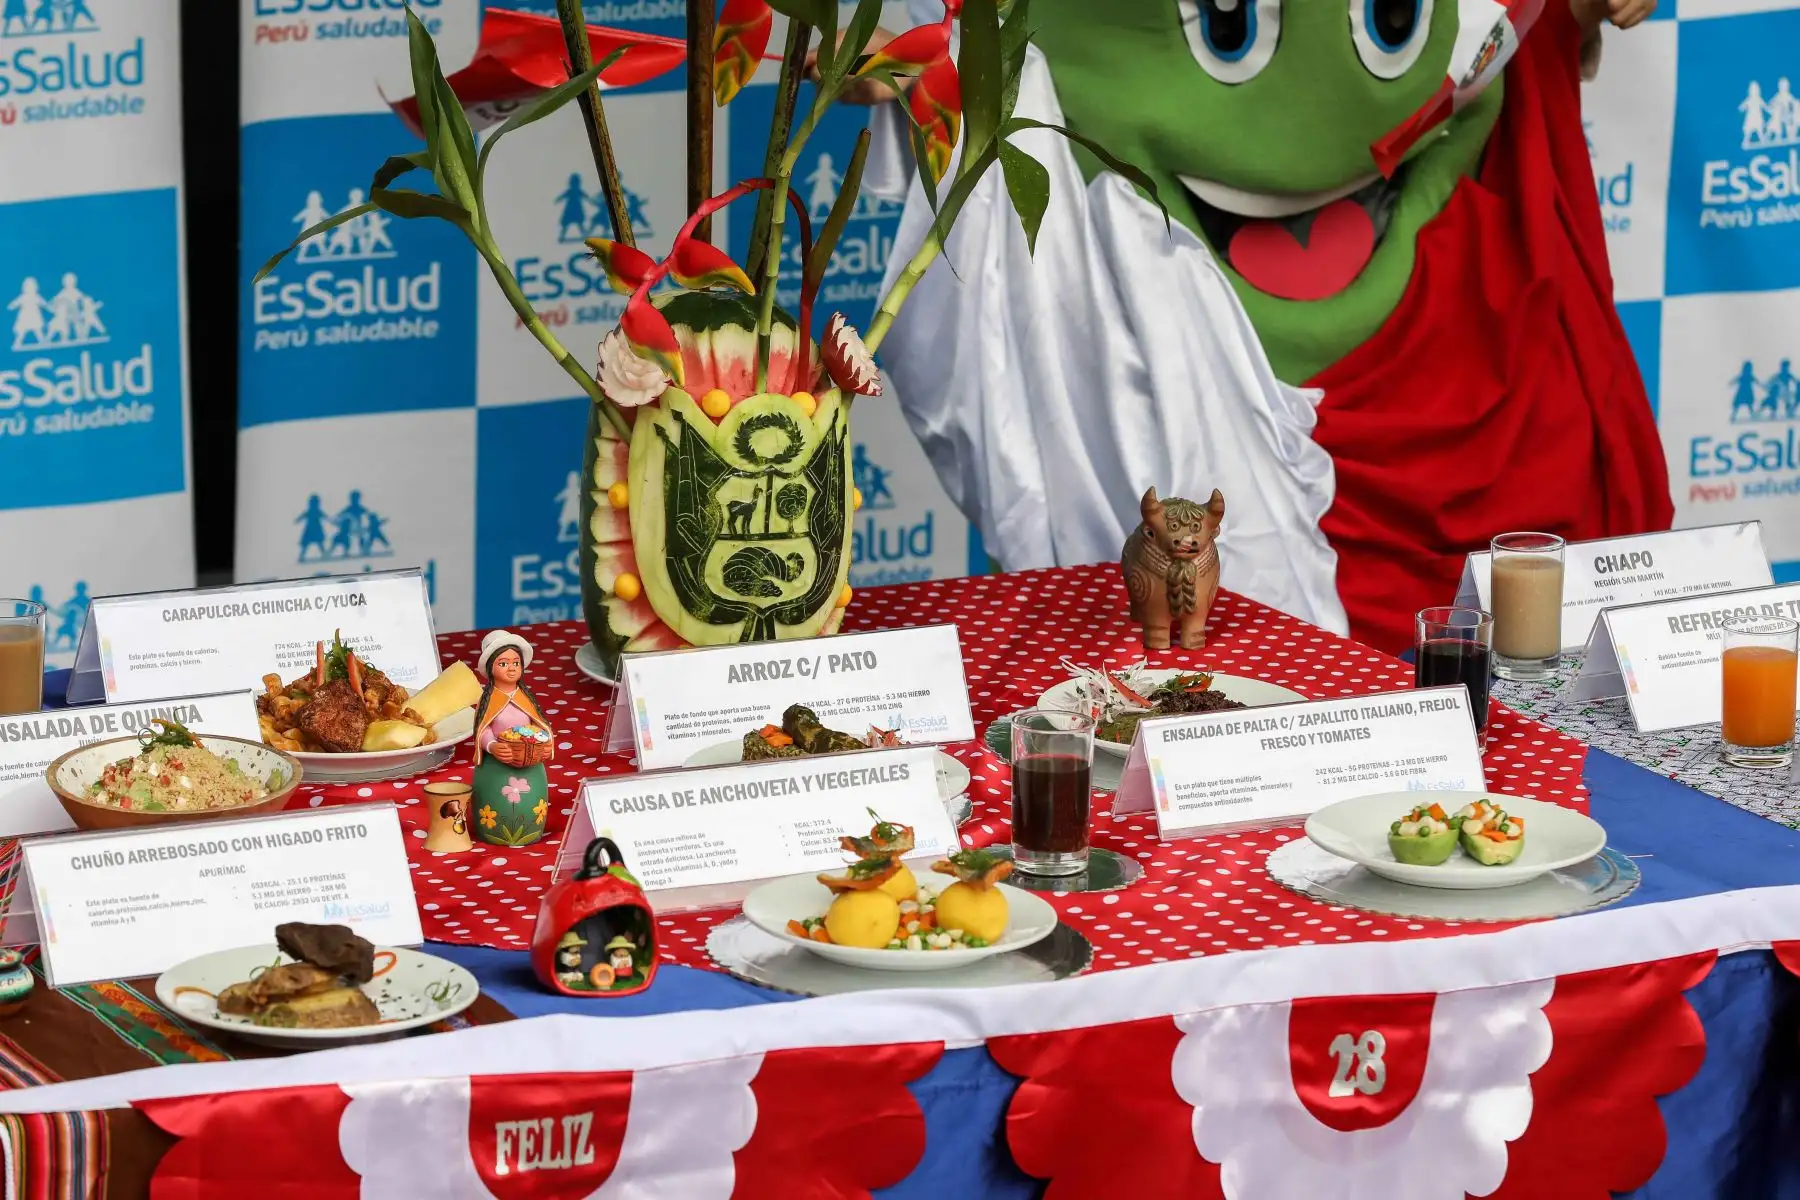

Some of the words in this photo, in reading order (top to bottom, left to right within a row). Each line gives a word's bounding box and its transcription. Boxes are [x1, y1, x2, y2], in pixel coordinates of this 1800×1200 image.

[254, 20, 308, 45] Perú
[315, 13, 443, 40] saludale
[23, 92, 145, 124] saludable
[253, 261, 442, 325] EsSalud
[254, 324, 308, 352] Perú
[314, 315, 440, 345] saludable
[33, 400, 155, 435] saludable
[1594, 550, 1654, 574] CHAPO
[1594, 576, 1622, 589] REGIÓN
[1622, 576, 1637, 585] SAN
[1637, 571, 1665, 583] MARTÍN
[1663, 587, 1678, 595] KCAL
[162, 603, 250, 623] CARAPULCRA
[252, 599, 313, 616] CHINCHA
[314, 592, 368, 612] C/YUCA
[1667, 605, 1758, 634] REFRESCO
[286, 641, 301, 650] KCAL
[1677, 650, 1695, 658] fuente
[142, 652, 157, 662] plato
[165, 649, 185, 658] fuente
[160, 659, 178, 668] calcio
[287, 651, 296, 659] DE
[293, 660, 305, 668] MG
[727, 659, 795, 684] ARROZ
[796, 655, 822, 680] C/
[828, 650, 878, 674] PATO
[816, 700, 832, 708] KCAL
[837, 697, 845, 706] 27
[851, 694, 881, 704] PROTEÍNA
[886, 693, 896, 701] 5.3
[908, 689, 931, 697] HIERRO
[664, 712, 681, 721] Plato
[681, 711, 689, 719] de
[689, 709, 707, 718] fondo
[708, 709, 719, 718] que
[720, 706, 740, 716] aporta
[752, 703, 771, 711] buena
[838, 706, 861, 715] CALCIO
[877, 703, 888, 711] MG
[90, 712, 118, 734] DE
[121, 703, 204, 732] QUINUA
[666, 721, 692, 731] cantidad
[693, 721, 701, 729] de
[733, 714, 756, 724] además
[757, 713, 765, 721] de
[908, 715, 948, 729] EsSalud
[1162, 724, 1224, 743] ENSALADA
[1226, 722, 1242, 735] DE
[1244, 718, 1279, 733] PALTA
[1280, 715, 1296, 731] C/
[1298, 708, 1359, 727] ZAPALLITO
[1361, 702, 1418, 720] ITALIANO,
[1419, 697, 1461, 713] FREJOL
[667, 730, 697, 740] vitaminas
[1260, 734, 1307, 751] FRESCO
[1307, 733, 1316, 746] Y
[1316, 727, 1371, 744] TOMATES
[4, 761, 25, 771] fuente
[25, 761, 34, 769] de
[1315, 768, 1328, 776] 242
[1328, 766, 1344, 775] KCAL
[1395, 759, 1406, 767] 2.3
[1406, 758, 1417, 766] MG
[1417, 757, 1425, 765] DE
[1425, 754, 1448, 764] HIERRO
[1174, 783, 1183, 791] Es
[1191, 780, 1207, 791] plato
[1207, 780, 1219, 789] que
[1219, 776, 1235, 786] tiene
[1235, 774, 1262, 785] múltiples
[1337, 775, 1348, 784] MG
[1348, 774, 1357, 783] DE
[1357, 772, 1379, 781] CALCIO
[1394, 769, 1400, 777] G
[1409, 767, 1427, 775] FIBRA
[609, 793, 670, 815] CAUSA
[672, 789, 697, 809] DE
[699, 776, 801, 806] ANCHOVETA
[801, 774, 813, 793] Y
[815, 763, 910, 791] VEGETALES
[1176, 791, 1209, 801] beneficios,
[1209, 787, 1229, 799] aporta
[1229, 785, 1260, 796] vitaminas,
[1260, 782, 1289, 791] minerales
[1178, 800, 1213, 811] compuestos
[1214, 797, 1253, 807] antioxidantes
[71, 850, 125, 871] CHUÑO
[128, 840, 229, 865] ARREBOSADO
[231, 835, 263, 853] CON
[266, 829, 324, 848] HIGADO
[326, 824, 368, 842] FRITO
[634, 840, 642, 848] Es
[643, 839, 655, 847] una
[655, 837, 675, 845] causa
[675, 833, 697, 844] rellena
[697, 832, 706, 840] de
[637, 846, 669, 857] anchoveta
[674, 842, 703, 852] verduras.
[703, 840, 712, 848] Es
[639, 856, 664, 867] entrada
[695, 852, 704, 860] La
[705, 847, 737, 859] anchoveta
[199, 864, 247, 878] APURÍMAC
[309, 872, 346, 883] PROTEÍNAS
[650, 867, 664, 876] rica
[673, 862, 703, 874] vitaminas
[263, 891, 275, 899] MG
[276, 890, 285, 898] DE
[286, 887, 312, 896] HIERRO
[335, 883, 347, 891] MG
[644, 878, 667, 888] Omega
[86, 899, 101, 907] Este
[101, 897, 119, 907] plato
[128, 895, 151, 904] fuente
[151, 892, 160, 900] de
[254, 902, 264, 910] DE
[90, 918, 120, 928] vitamina
[1328, 1030, 1386, 1098] 28
[495, 1111, 595, 1176] FELIZ
